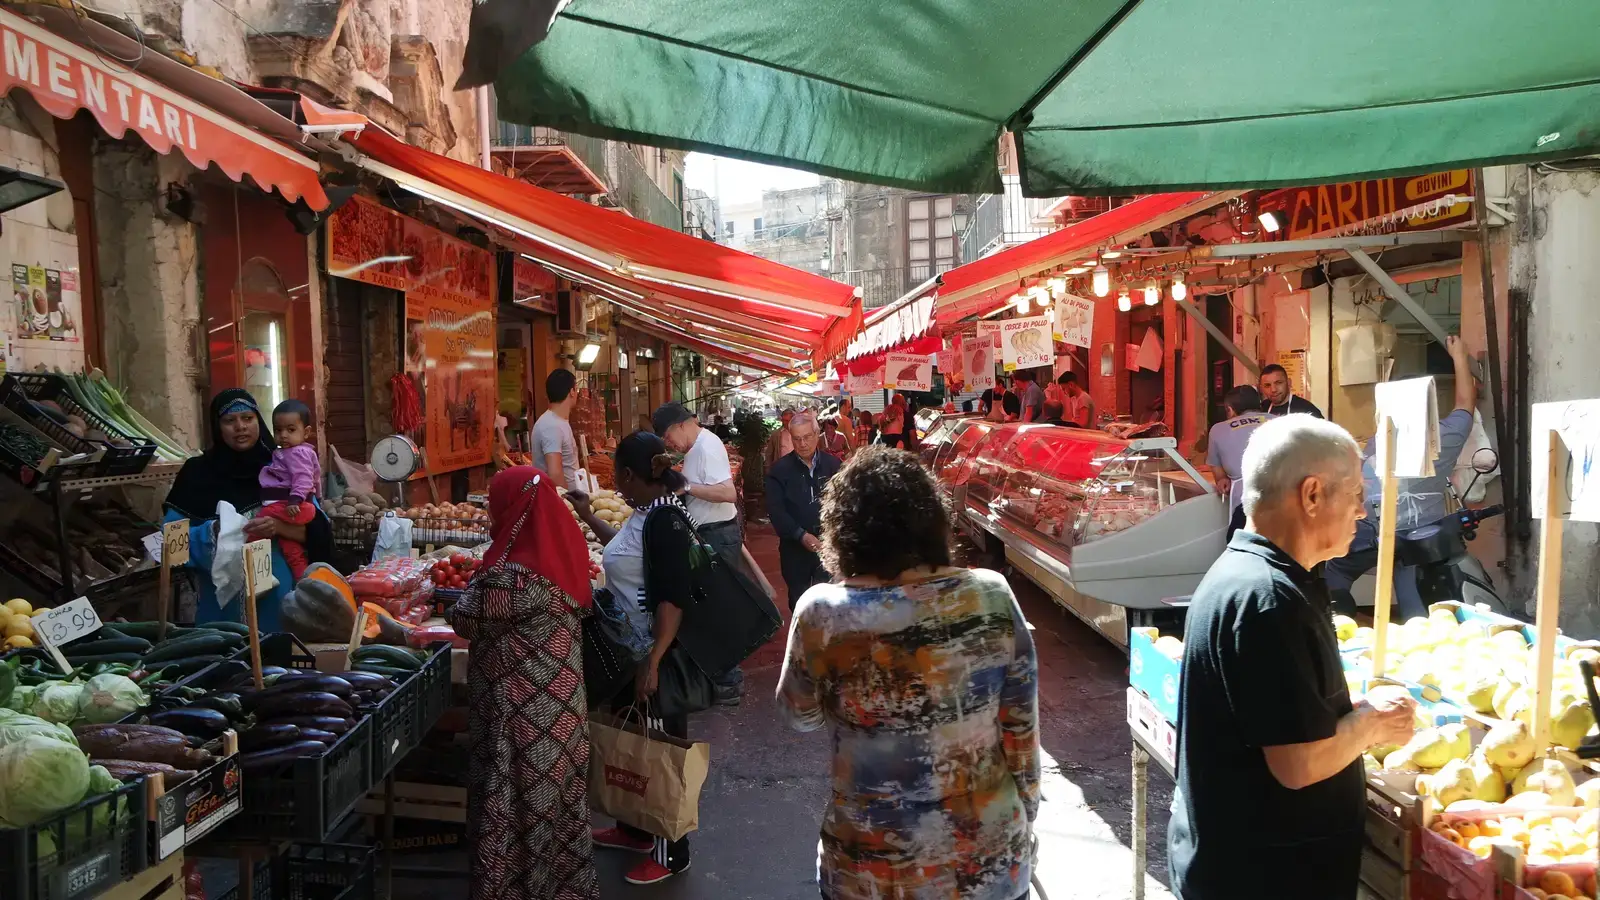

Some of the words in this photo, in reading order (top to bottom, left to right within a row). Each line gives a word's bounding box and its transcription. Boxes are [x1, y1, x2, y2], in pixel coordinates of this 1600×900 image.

[4, 29, 197, 150] MENTARI
[1416, 171, 1452, 195] BOVINI
[372, 272, 405, 289] TANTO
[1075, 302, 1090, 310] POLLO
[1004, 322, 1022, 331] COSCE
[1023, 321, 1030, 329] DI
[1031, 319, 1048, 328] POLLO
